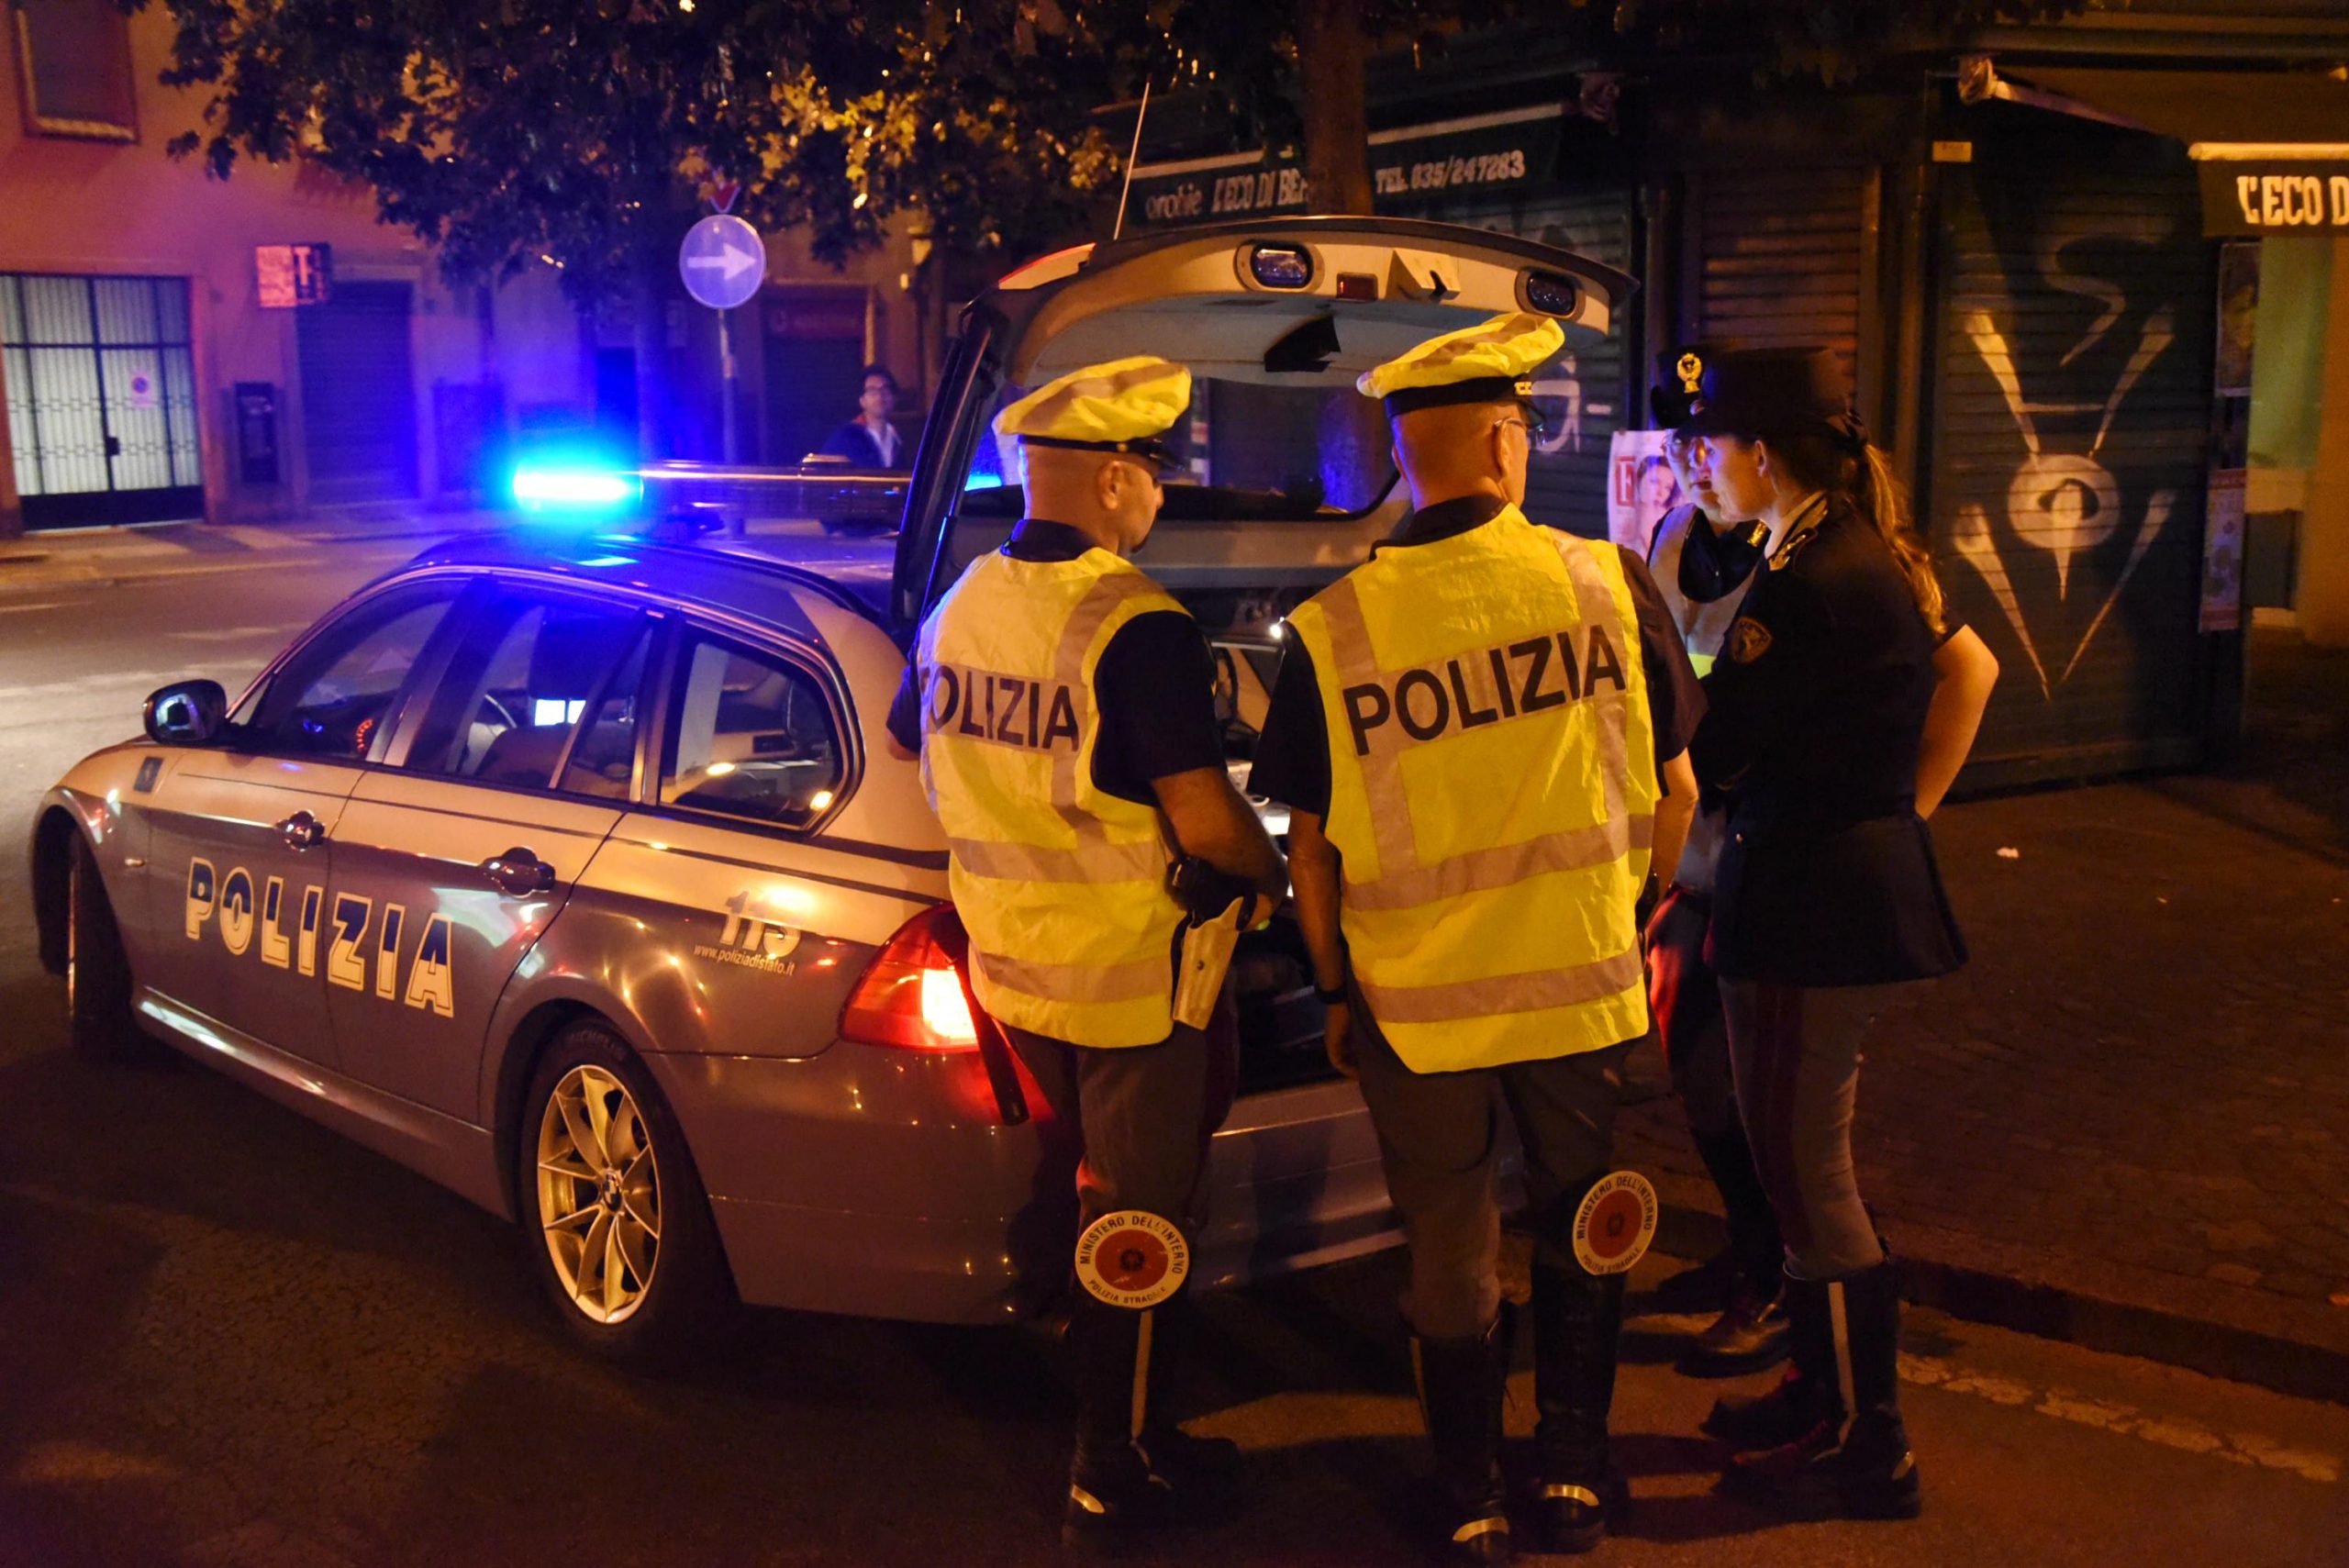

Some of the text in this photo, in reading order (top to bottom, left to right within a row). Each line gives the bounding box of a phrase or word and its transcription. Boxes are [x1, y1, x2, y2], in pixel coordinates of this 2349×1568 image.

[1255, 171, 1275, 209] DI
[2236, 175, 2323, 226] L'ECO
[1342, 625, 1627, 756] POLIZIA
[184, 856, 455, 1018] POLIZIA
[694, 944, 796, 976] www.poliziadistato.it
[1079, 1216, 1125, 1264] MINISTERO
